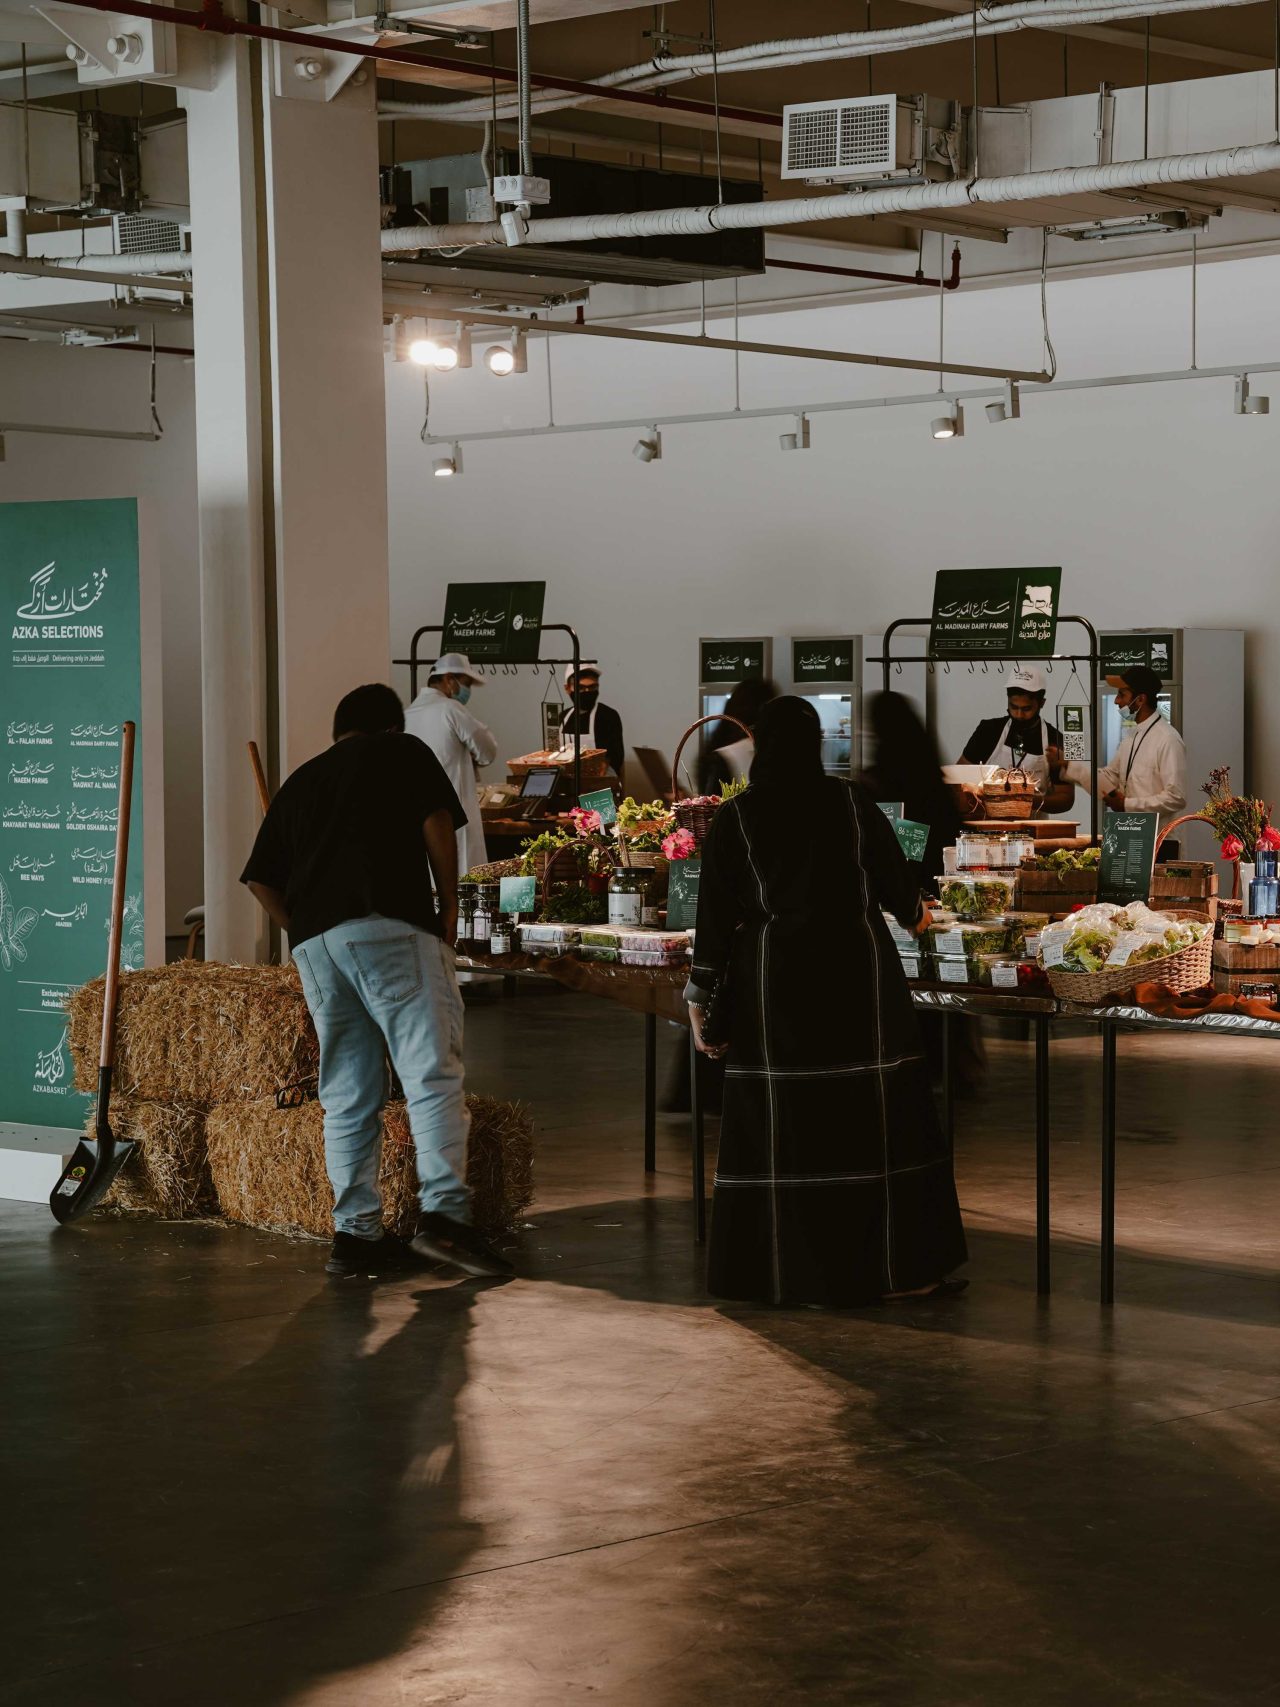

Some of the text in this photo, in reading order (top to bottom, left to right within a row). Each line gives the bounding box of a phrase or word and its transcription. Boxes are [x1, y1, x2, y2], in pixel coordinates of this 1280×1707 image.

[12, 626, 104, 639] AZKA SELECTIONS
[52, 654, 74, 664] Delivering
[74, 655, 84, 663] only
[33, 1084, 67, 1095] AZKABASKET
